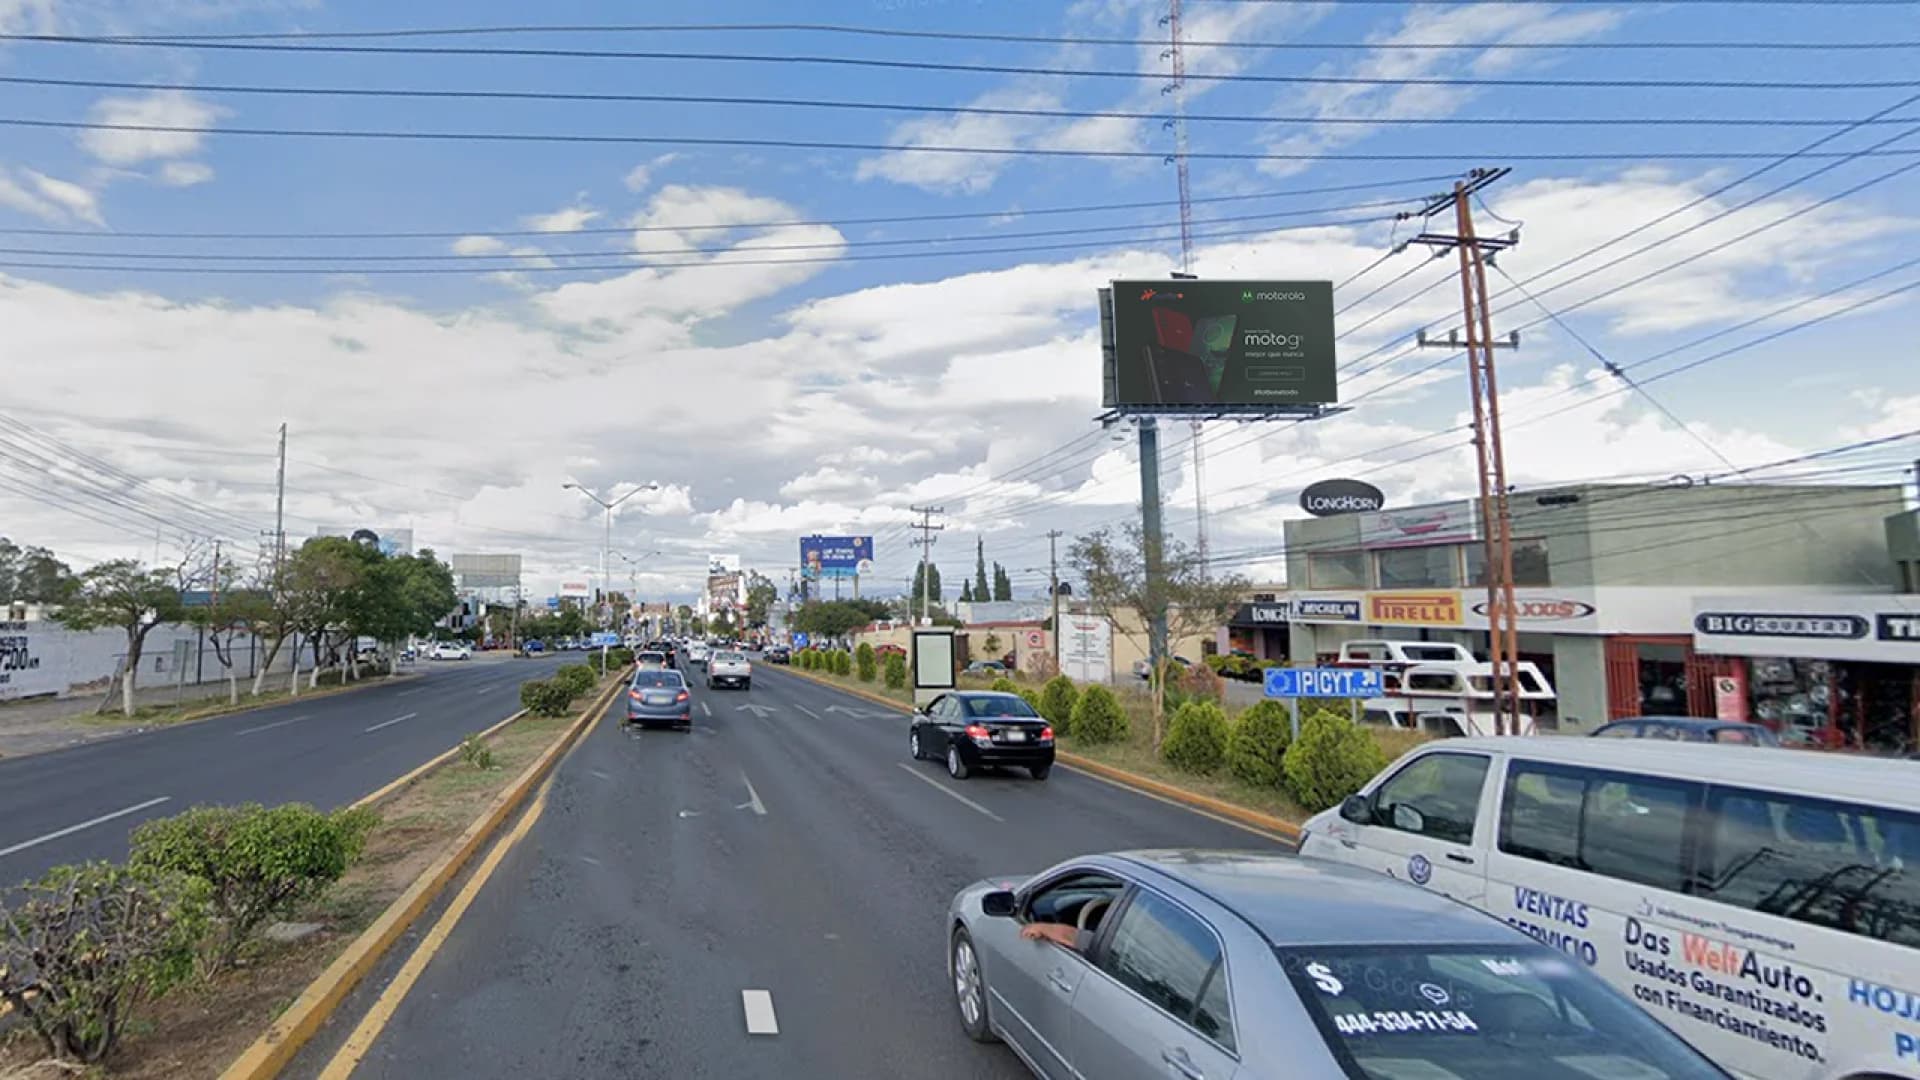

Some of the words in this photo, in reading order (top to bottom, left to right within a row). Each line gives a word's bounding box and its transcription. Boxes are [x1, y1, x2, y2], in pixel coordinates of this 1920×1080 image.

[1256, 289, 1306, 300] motorola
[1303, 602, 1358, 615] MICHELIN
[1373, 596, 1456, 621] PIRELLI
[1706, 616, 1751, 632] BIG
[1752, 619, 1852, 634] COUNTRY
[1296, 670, 1353, 693] IPICYT
[1515, 887, 1588, 929] VENTAS
[1625, 916, 1670, 955] Das
[1625, 950, 1687, 987] Usados
[1690, 971, 1826, 1032] Garantizados
[1848, 978, 1920, 1021] HOJ
[1334, 1010, 1478, 1034] 444-334-71-54
[1633, 983, 1664, 1006] con
[1666, 990, 1826, 1064] Financiamiento.
